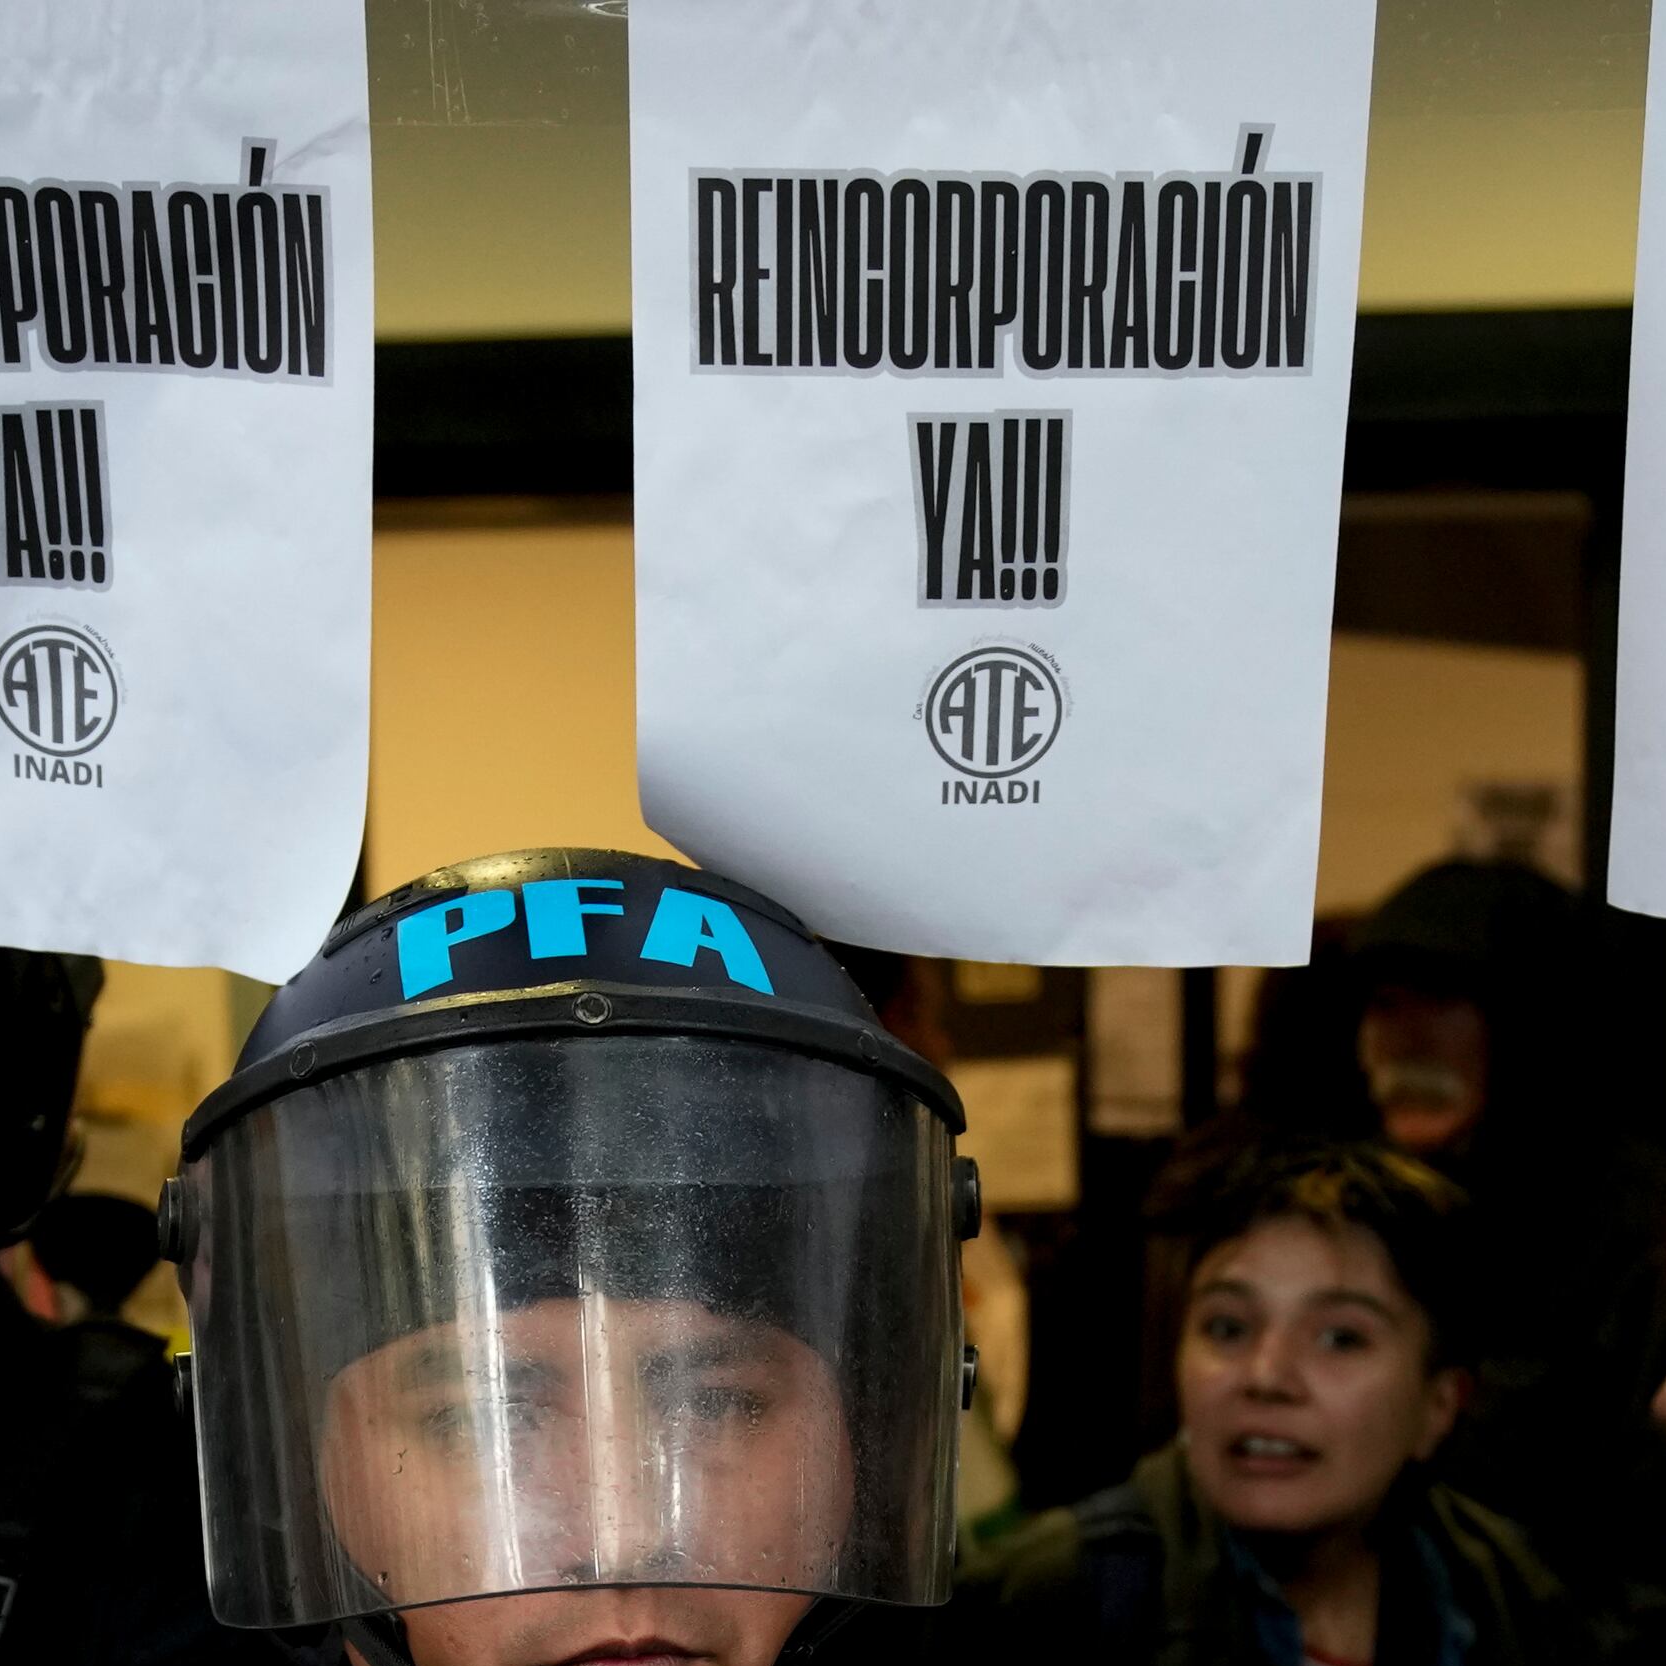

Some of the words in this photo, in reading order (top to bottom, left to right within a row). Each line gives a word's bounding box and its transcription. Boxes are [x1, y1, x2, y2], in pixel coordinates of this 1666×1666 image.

[697, 133, 1313, 371] REINCORPORACIÓN
[916, 418, 1064, 601] YA!!!
[2, 638, 102, 745] ATE
[939, 659, 1046, 767] ATE
[13, 753, 104, 788] INADI
[942, 780, 1041, 805] INADI
[396, 878, 775, 1001] PFA
